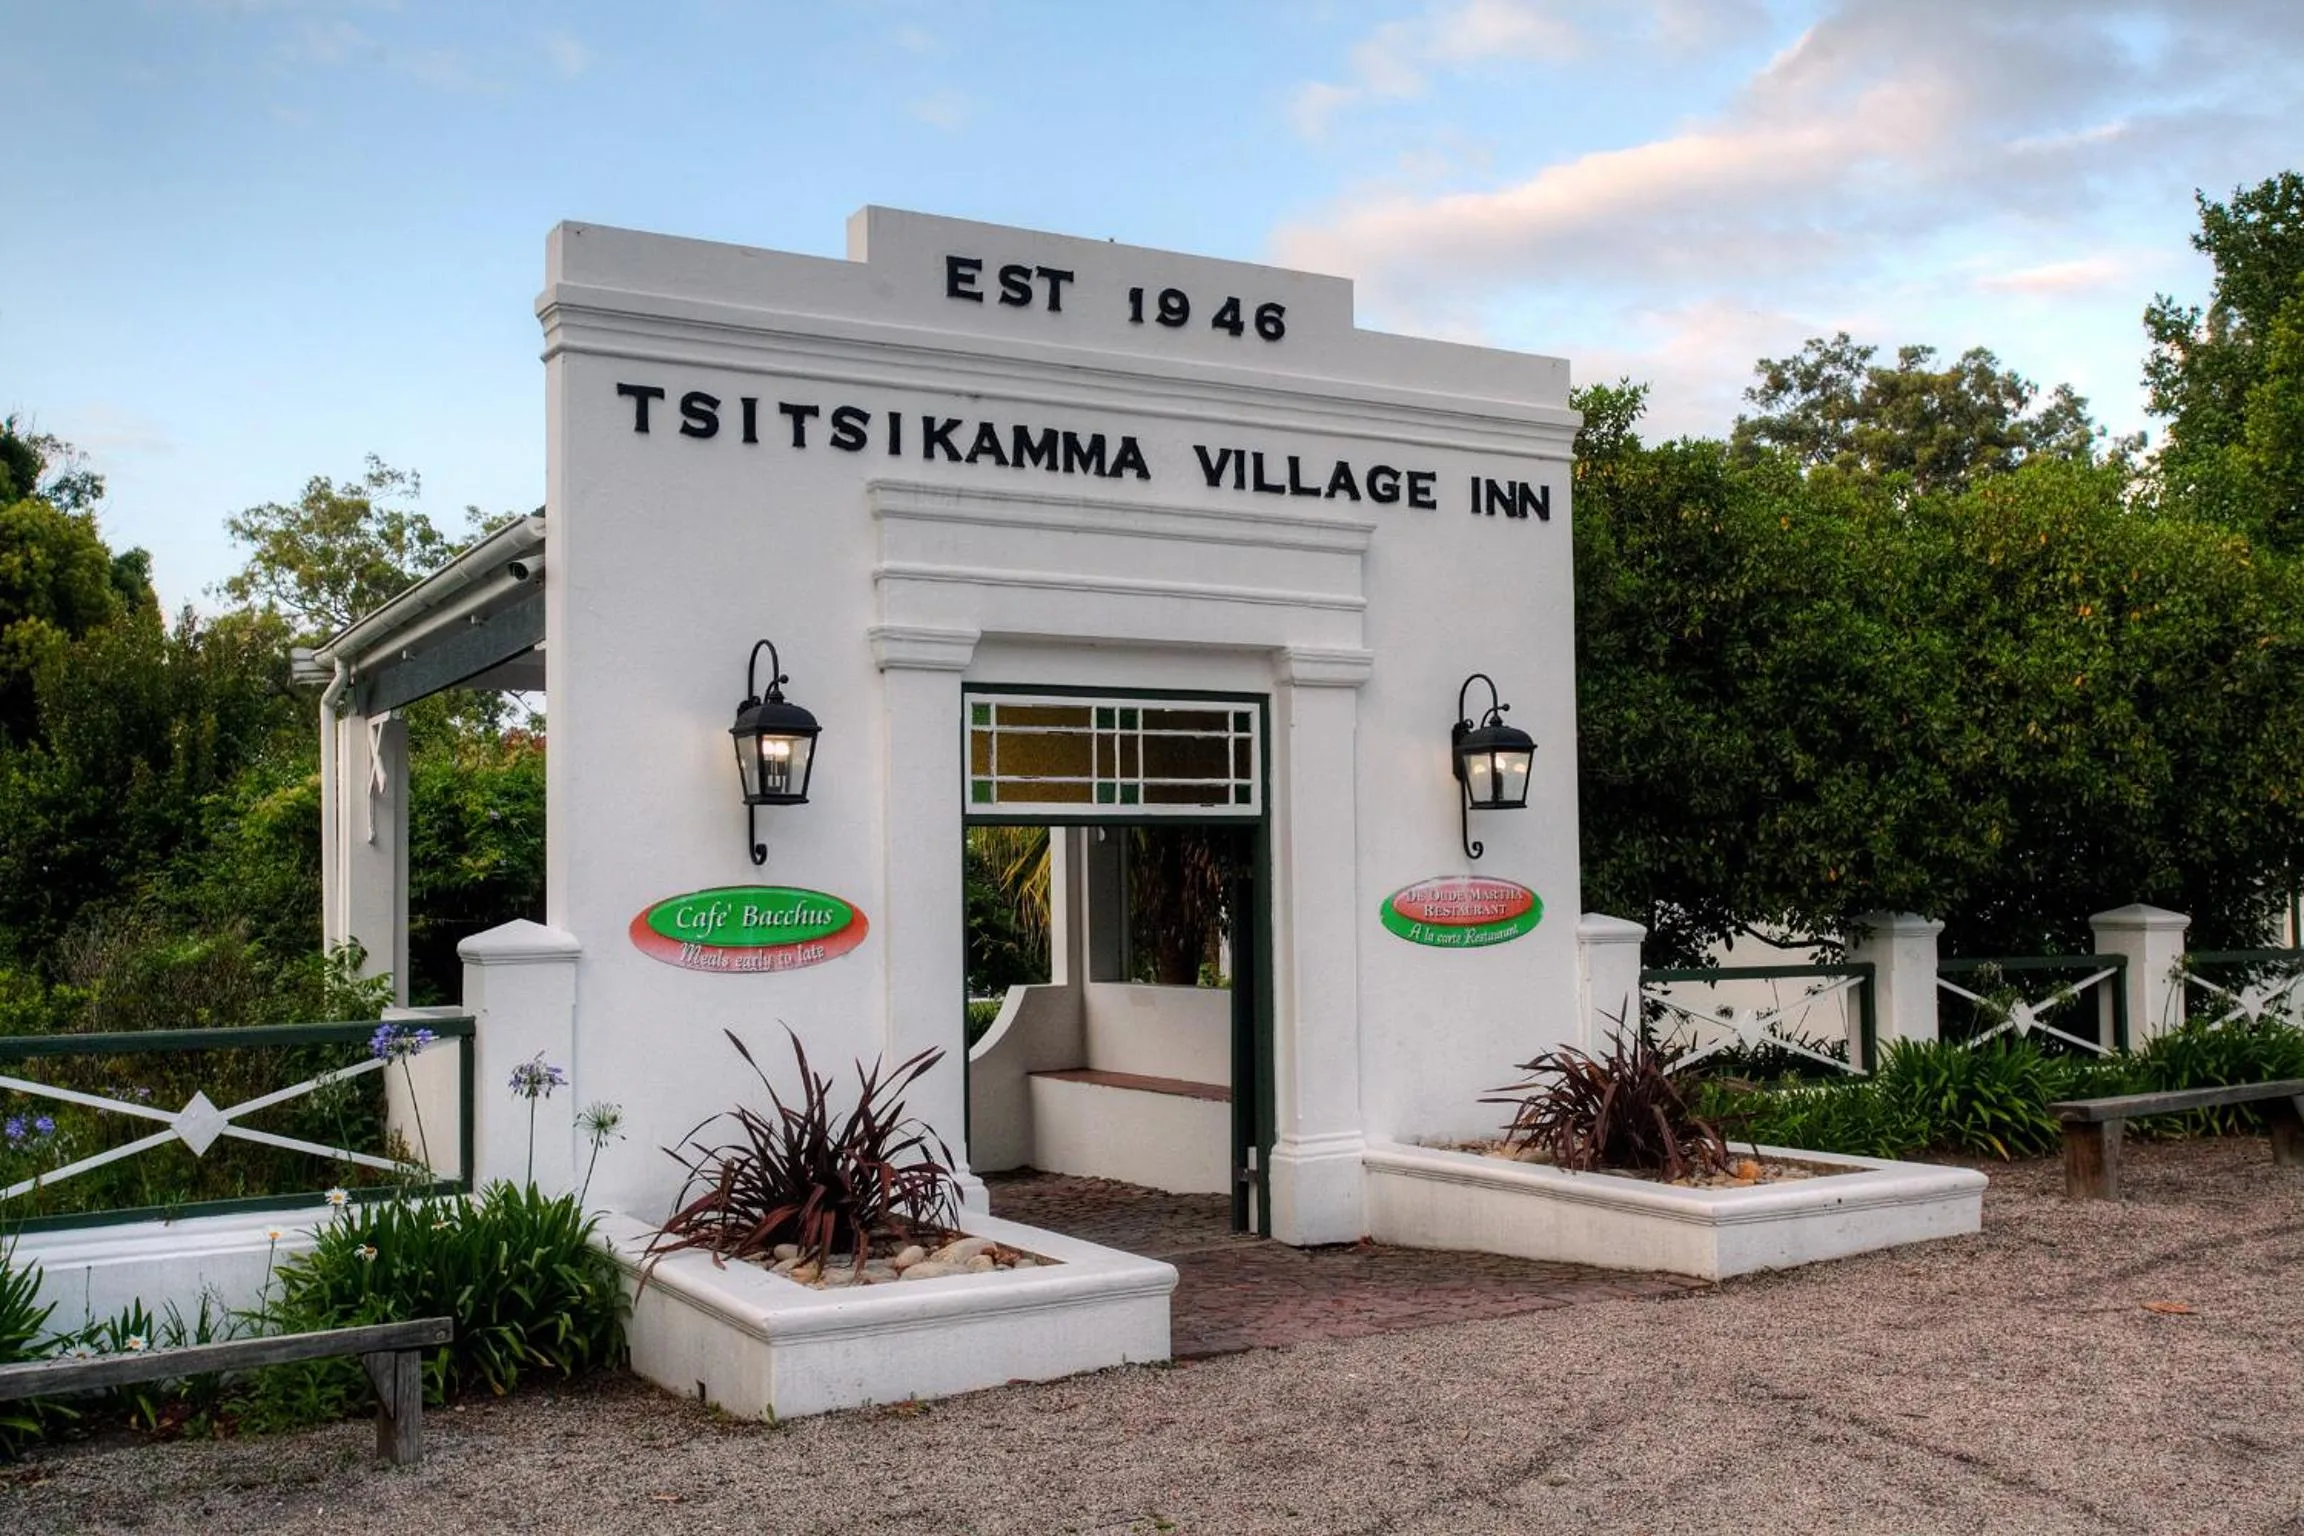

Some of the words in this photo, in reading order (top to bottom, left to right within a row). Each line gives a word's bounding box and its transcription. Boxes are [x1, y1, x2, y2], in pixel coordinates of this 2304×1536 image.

[945, 255, 1074, 312] EST
[1128, 286, 1287, 342] 1946
[617, 382, 1150, 480] TSITSIKAMMA
[1193, 445, 1438, 510] VILLAGE
[1471, 476, 1550, 521] INN
[742, 899, 833, 929] Bacchus
[1423, 904, 1507, 918] RESTAURANT
[1408, 923, 1421, 939] A
[1425, 926, 1434, 942] la
[1437, 934, 1461, 944] carte
[1464, 924, 1519, 945] Restaurant
[679, 942, 729, 968] Meals
[735, 949, 772, 971] early
[776, 950, 792, 965] to
[798, 943, 825, 962] late
